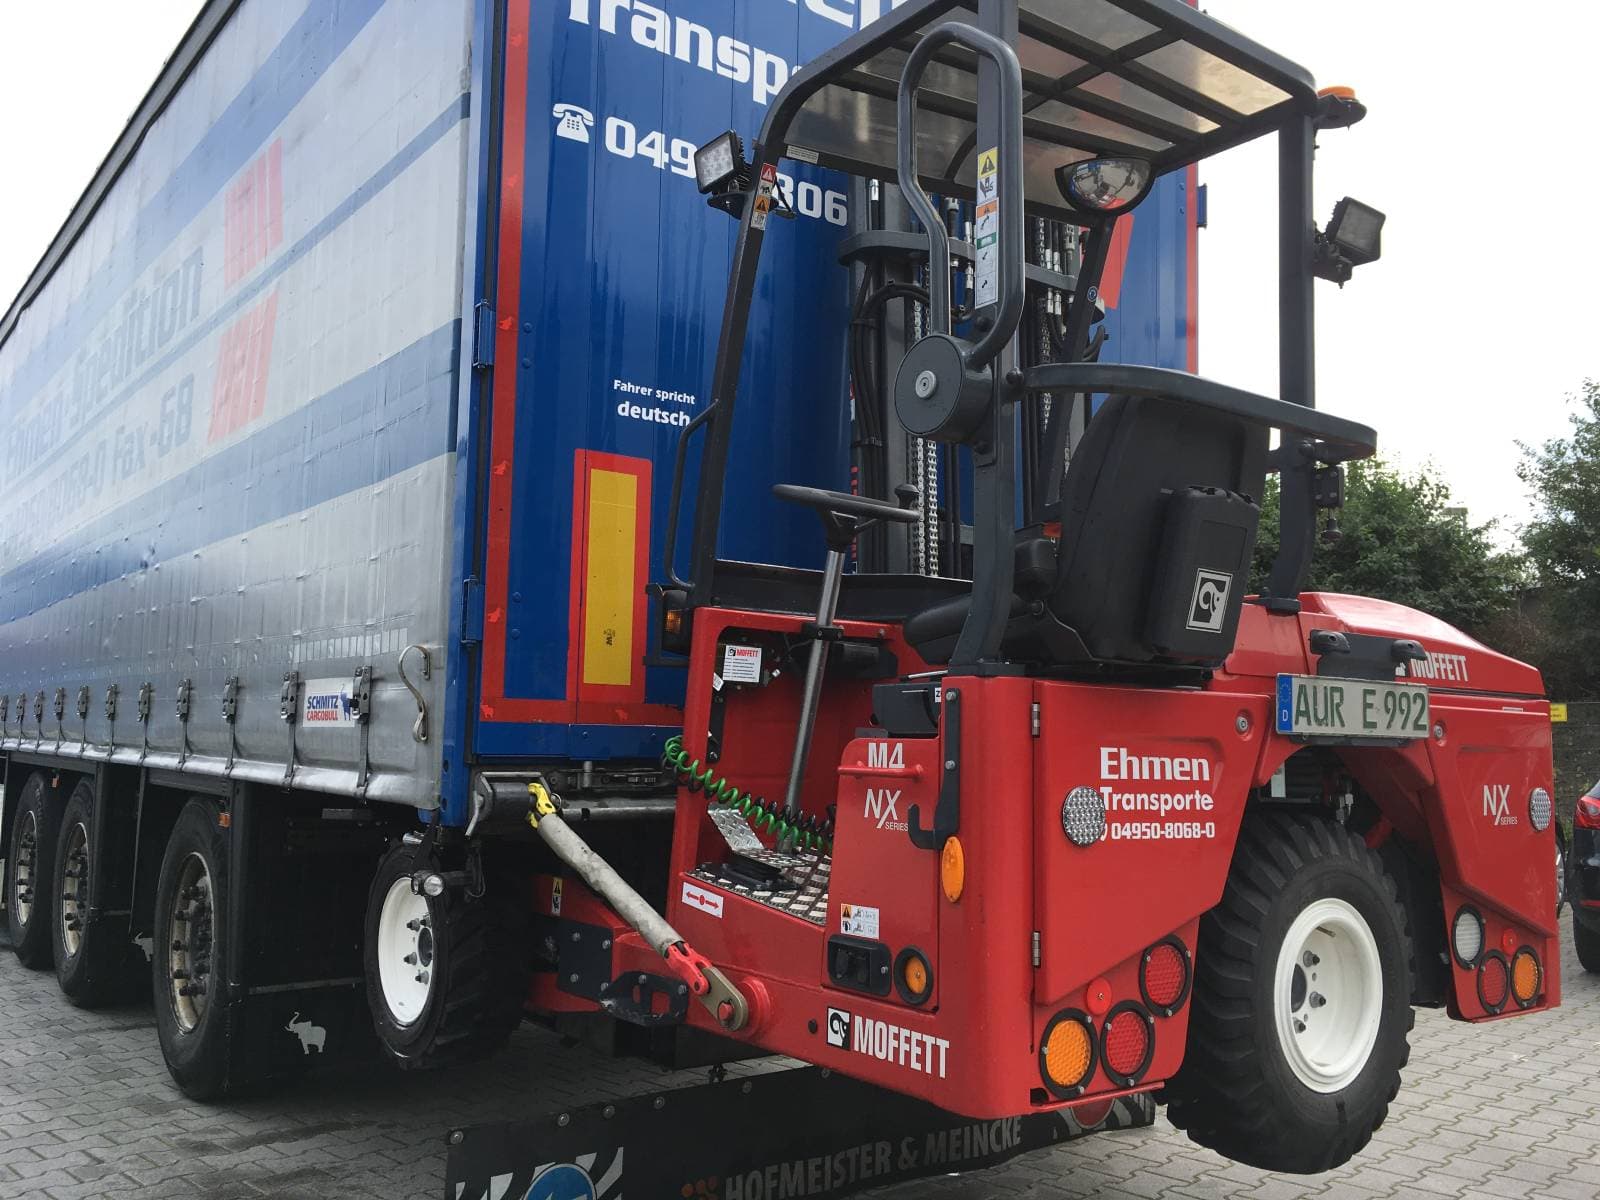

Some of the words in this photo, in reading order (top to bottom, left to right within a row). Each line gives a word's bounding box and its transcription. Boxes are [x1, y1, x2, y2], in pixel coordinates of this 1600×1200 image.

[68, 246, 203, 428] Spedition
[613, 379, 653, 396] Fahrer
[655, 389, 696, 405] spricht
[617, 400, 691, 427] deutsch
[736, 648, 759, 658] MOFFETT
[307, 695, 339, 709] SCHMITZ
[307, 710, 339, 721] CARGOBULL
[1282, 709, 1289, 722] D
[1294, 683, 1345, 728] AUR
[1362, 688, 1378, 729] E
[1384, 690, 1428, 732] 992
[867, 742, 906, 769] M4
[1100, 747, 1210, 781] Ehmen
[864, 788, 902, 829] NX
[1100, 786, 1215, 816] Transporte
[1483, 784, 1511, 826] NX
[884, 820, 909, 832] SERIES
[1111, 822, 1216, 839] 04950-8068-0
[1500, 816, 1518, 825] SERIES
[854, 1015, 950, 1079] MOFFETT
[725, 1140, 892, 1200] HOFMEISTER
[898, 1136, 919, 1170] &
[923, 1115, 1022, 1167] MEINCKE
